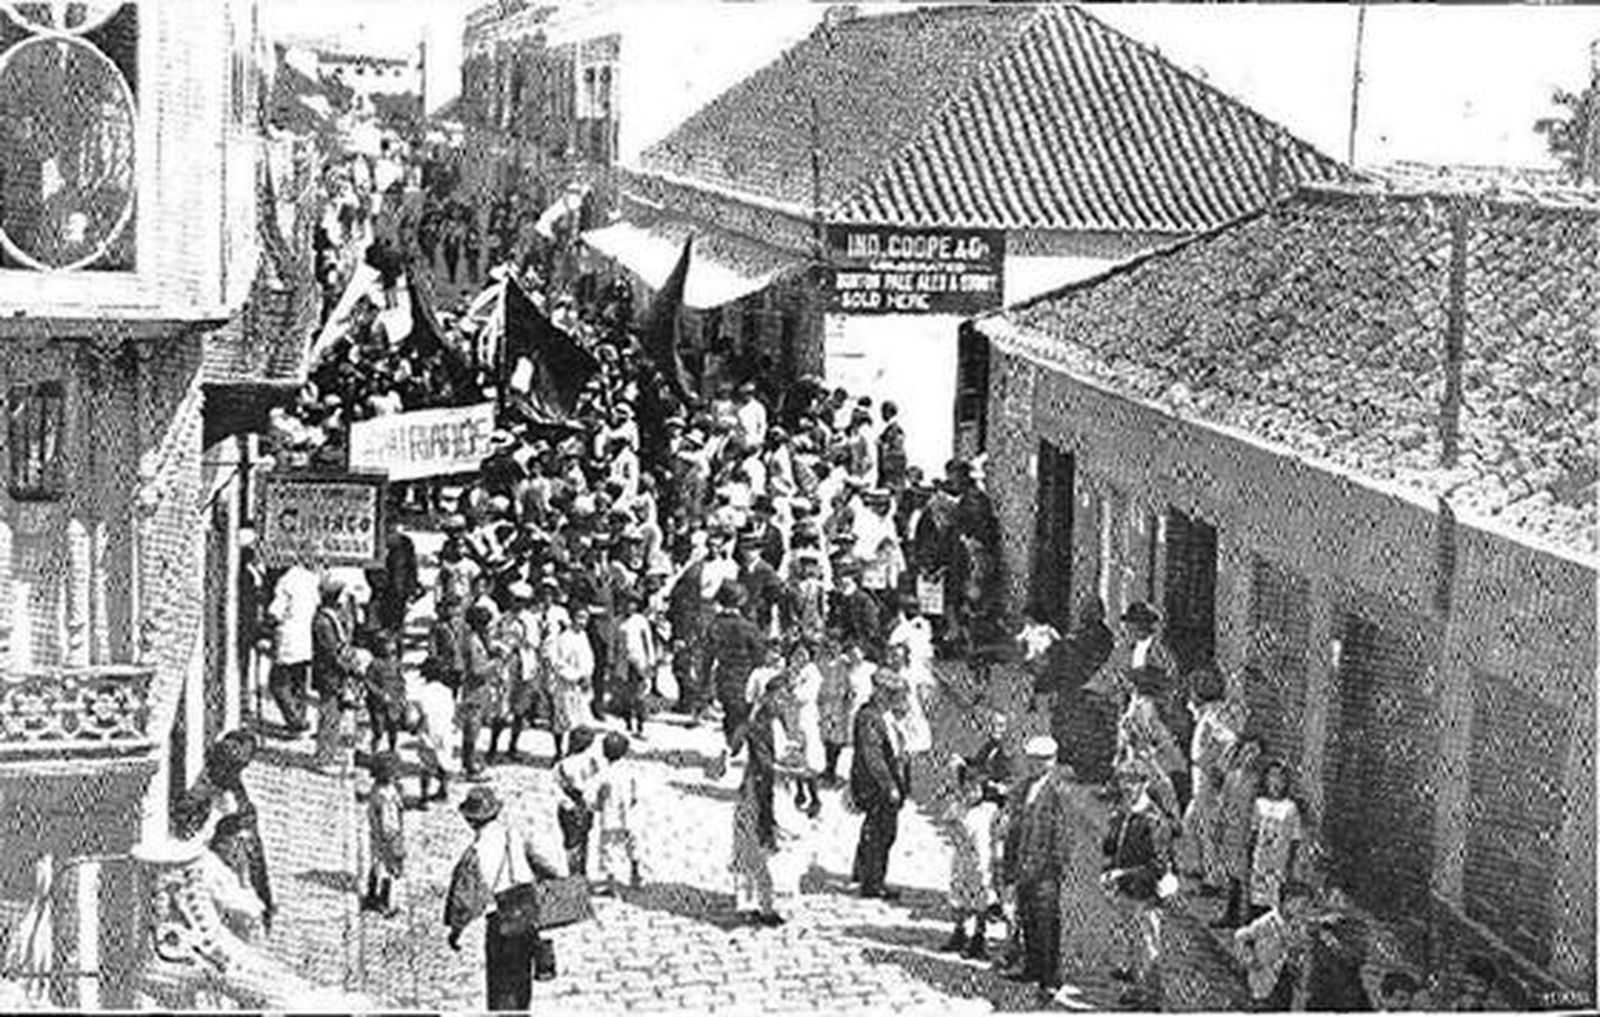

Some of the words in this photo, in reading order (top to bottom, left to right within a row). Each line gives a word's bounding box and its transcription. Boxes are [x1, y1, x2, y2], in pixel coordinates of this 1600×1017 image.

[888, 235, 952, 259] COOPE
[884, 273, 914, 292] PALE
[841, 291, 881, 309] SOLD
[886, 293, 930, 310] HERE
